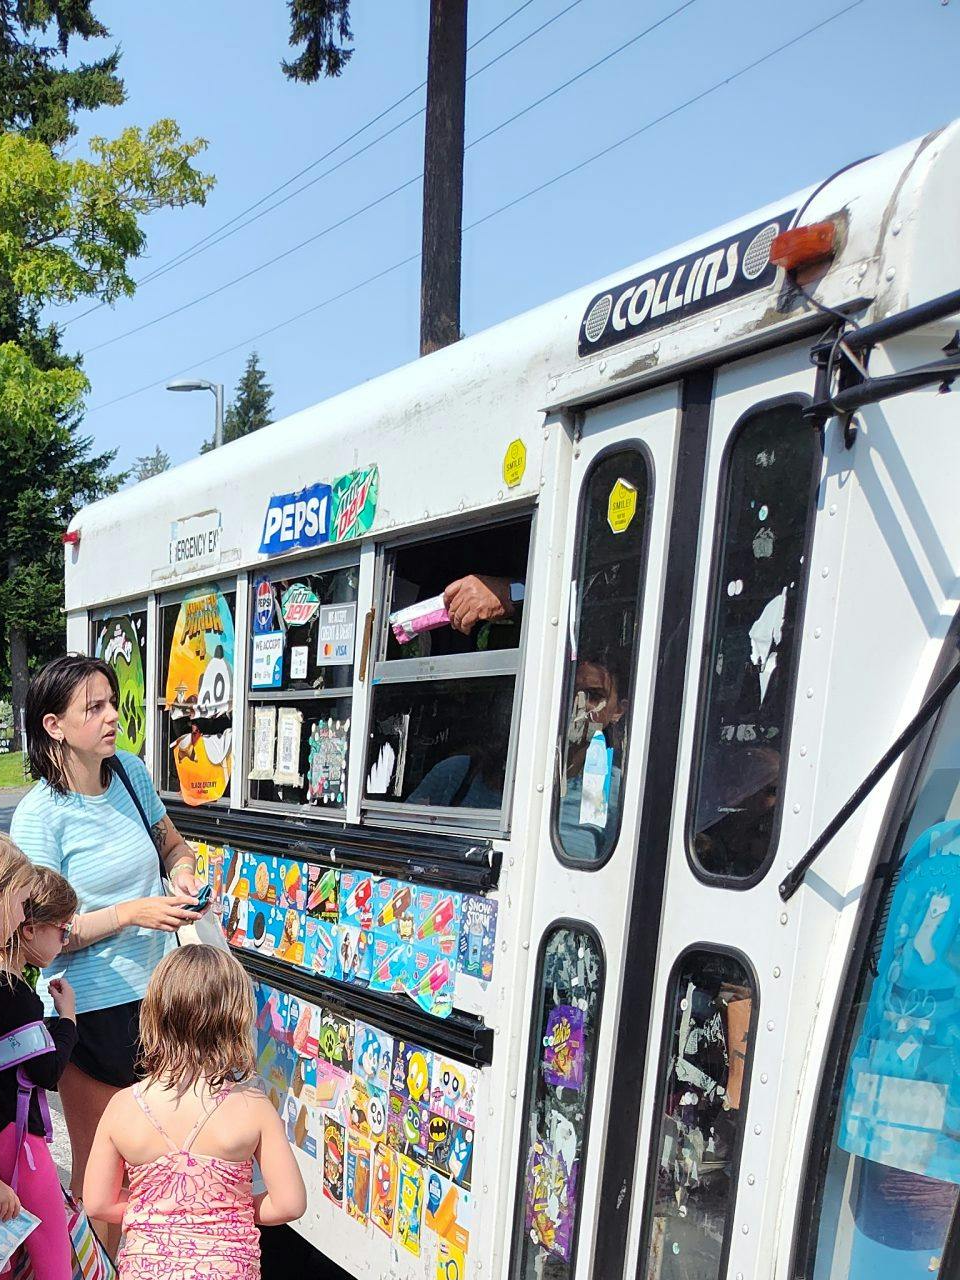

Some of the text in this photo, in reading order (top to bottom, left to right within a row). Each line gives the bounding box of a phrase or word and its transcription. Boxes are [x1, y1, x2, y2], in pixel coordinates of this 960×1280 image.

[612, 241, 739, 331] COLLINS
[264, 496, 327, 544] PEPSI
[469, 897, 492, 914] SNOW
